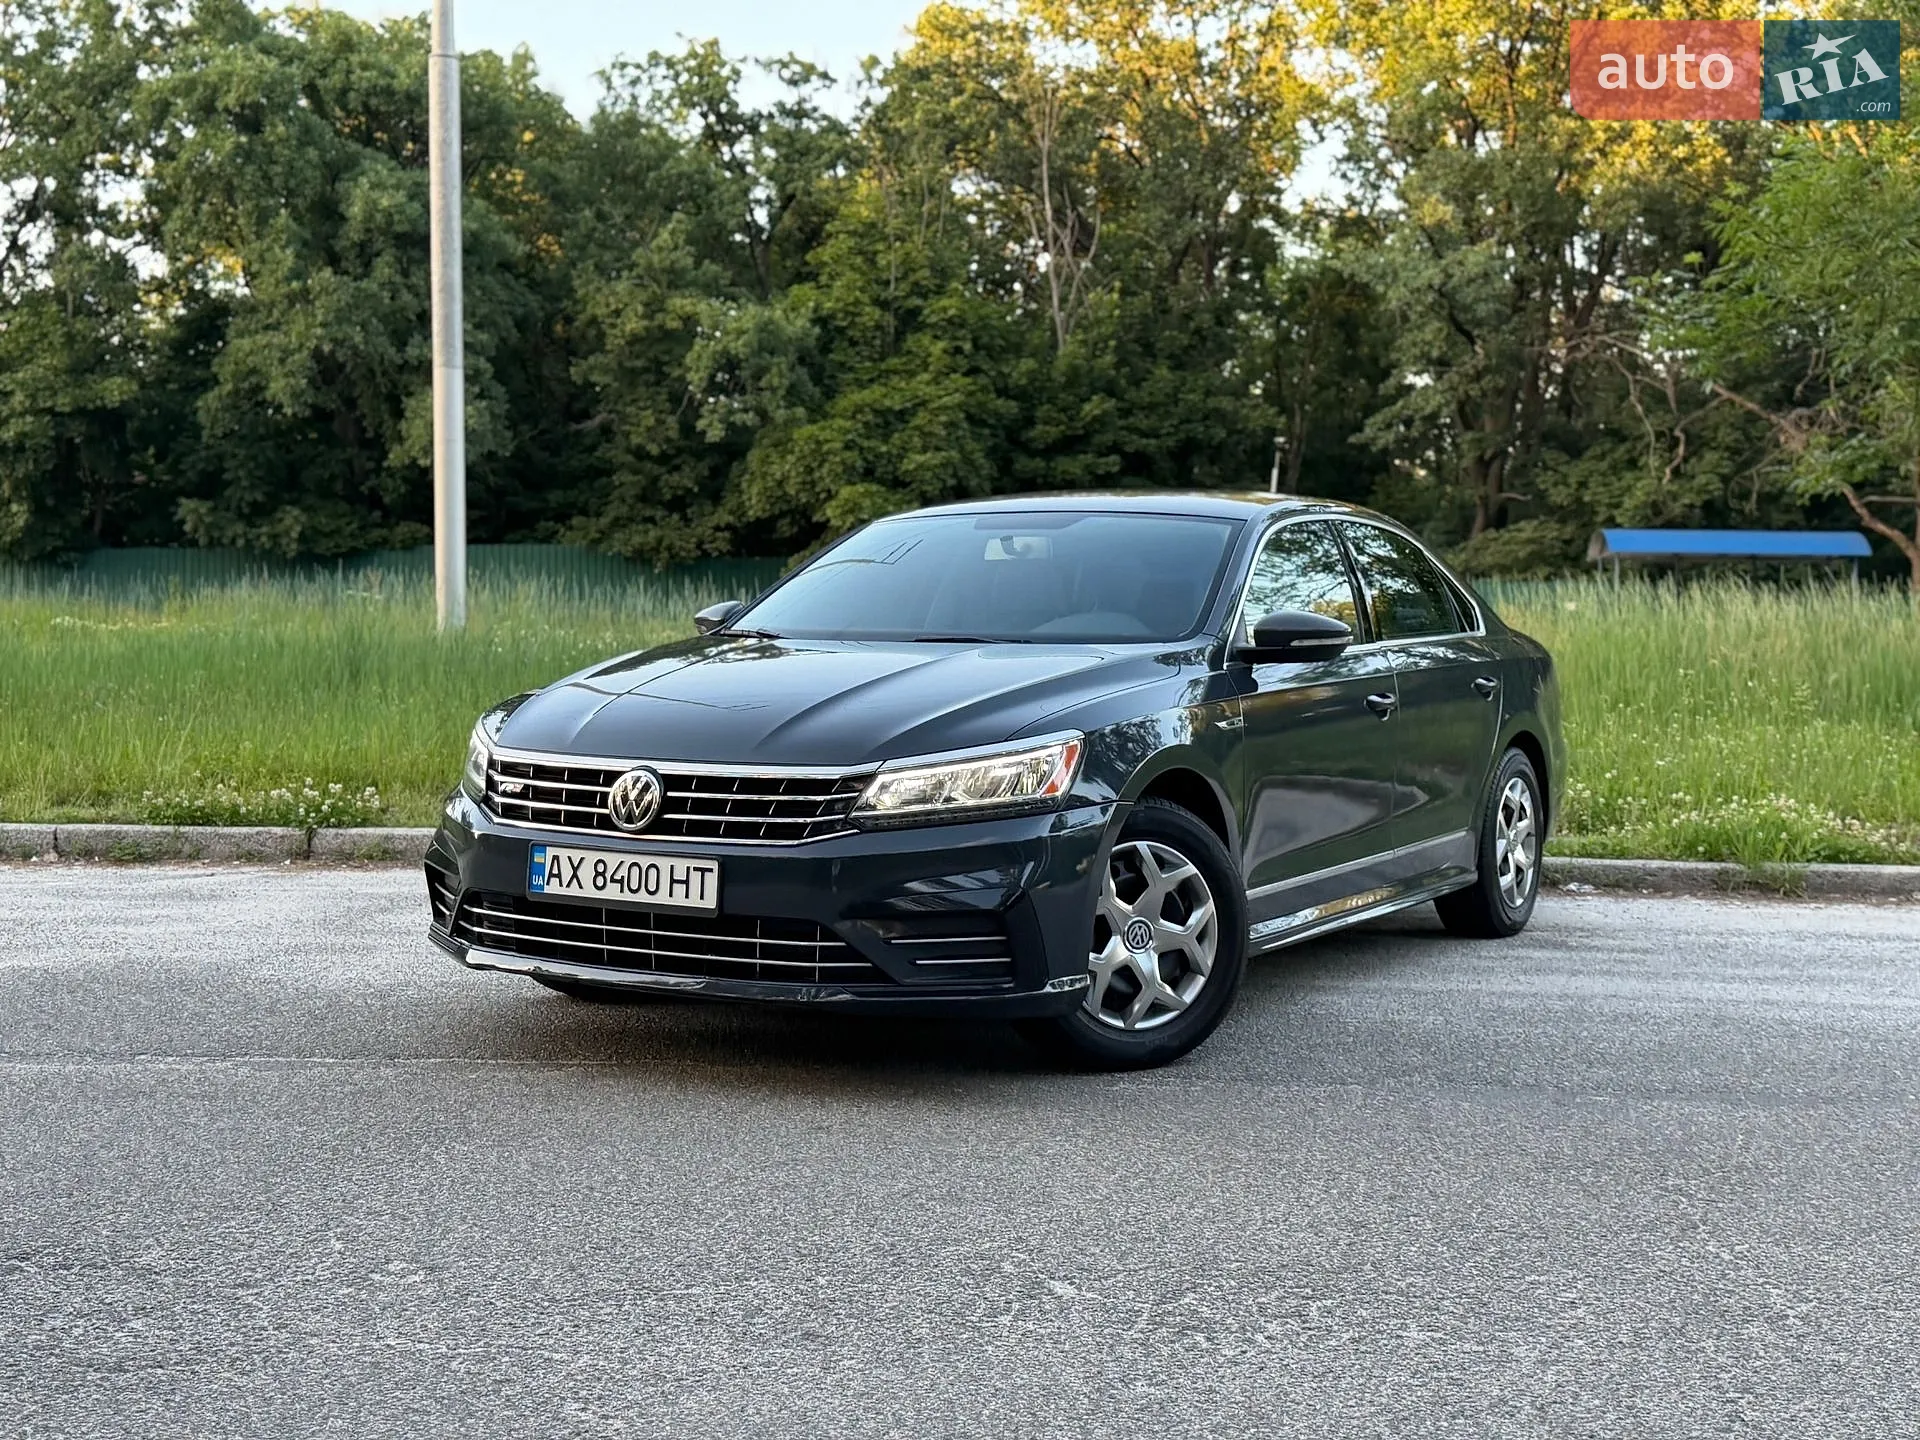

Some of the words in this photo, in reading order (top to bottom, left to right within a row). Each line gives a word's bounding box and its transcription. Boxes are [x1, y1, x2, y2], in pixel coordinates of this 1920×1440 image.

[532, 874, 544, 886] UA
[546, 854, 586, 889] AX
[592, 858, 661, 896] 8400
[668, 864, 714, 901] HT
